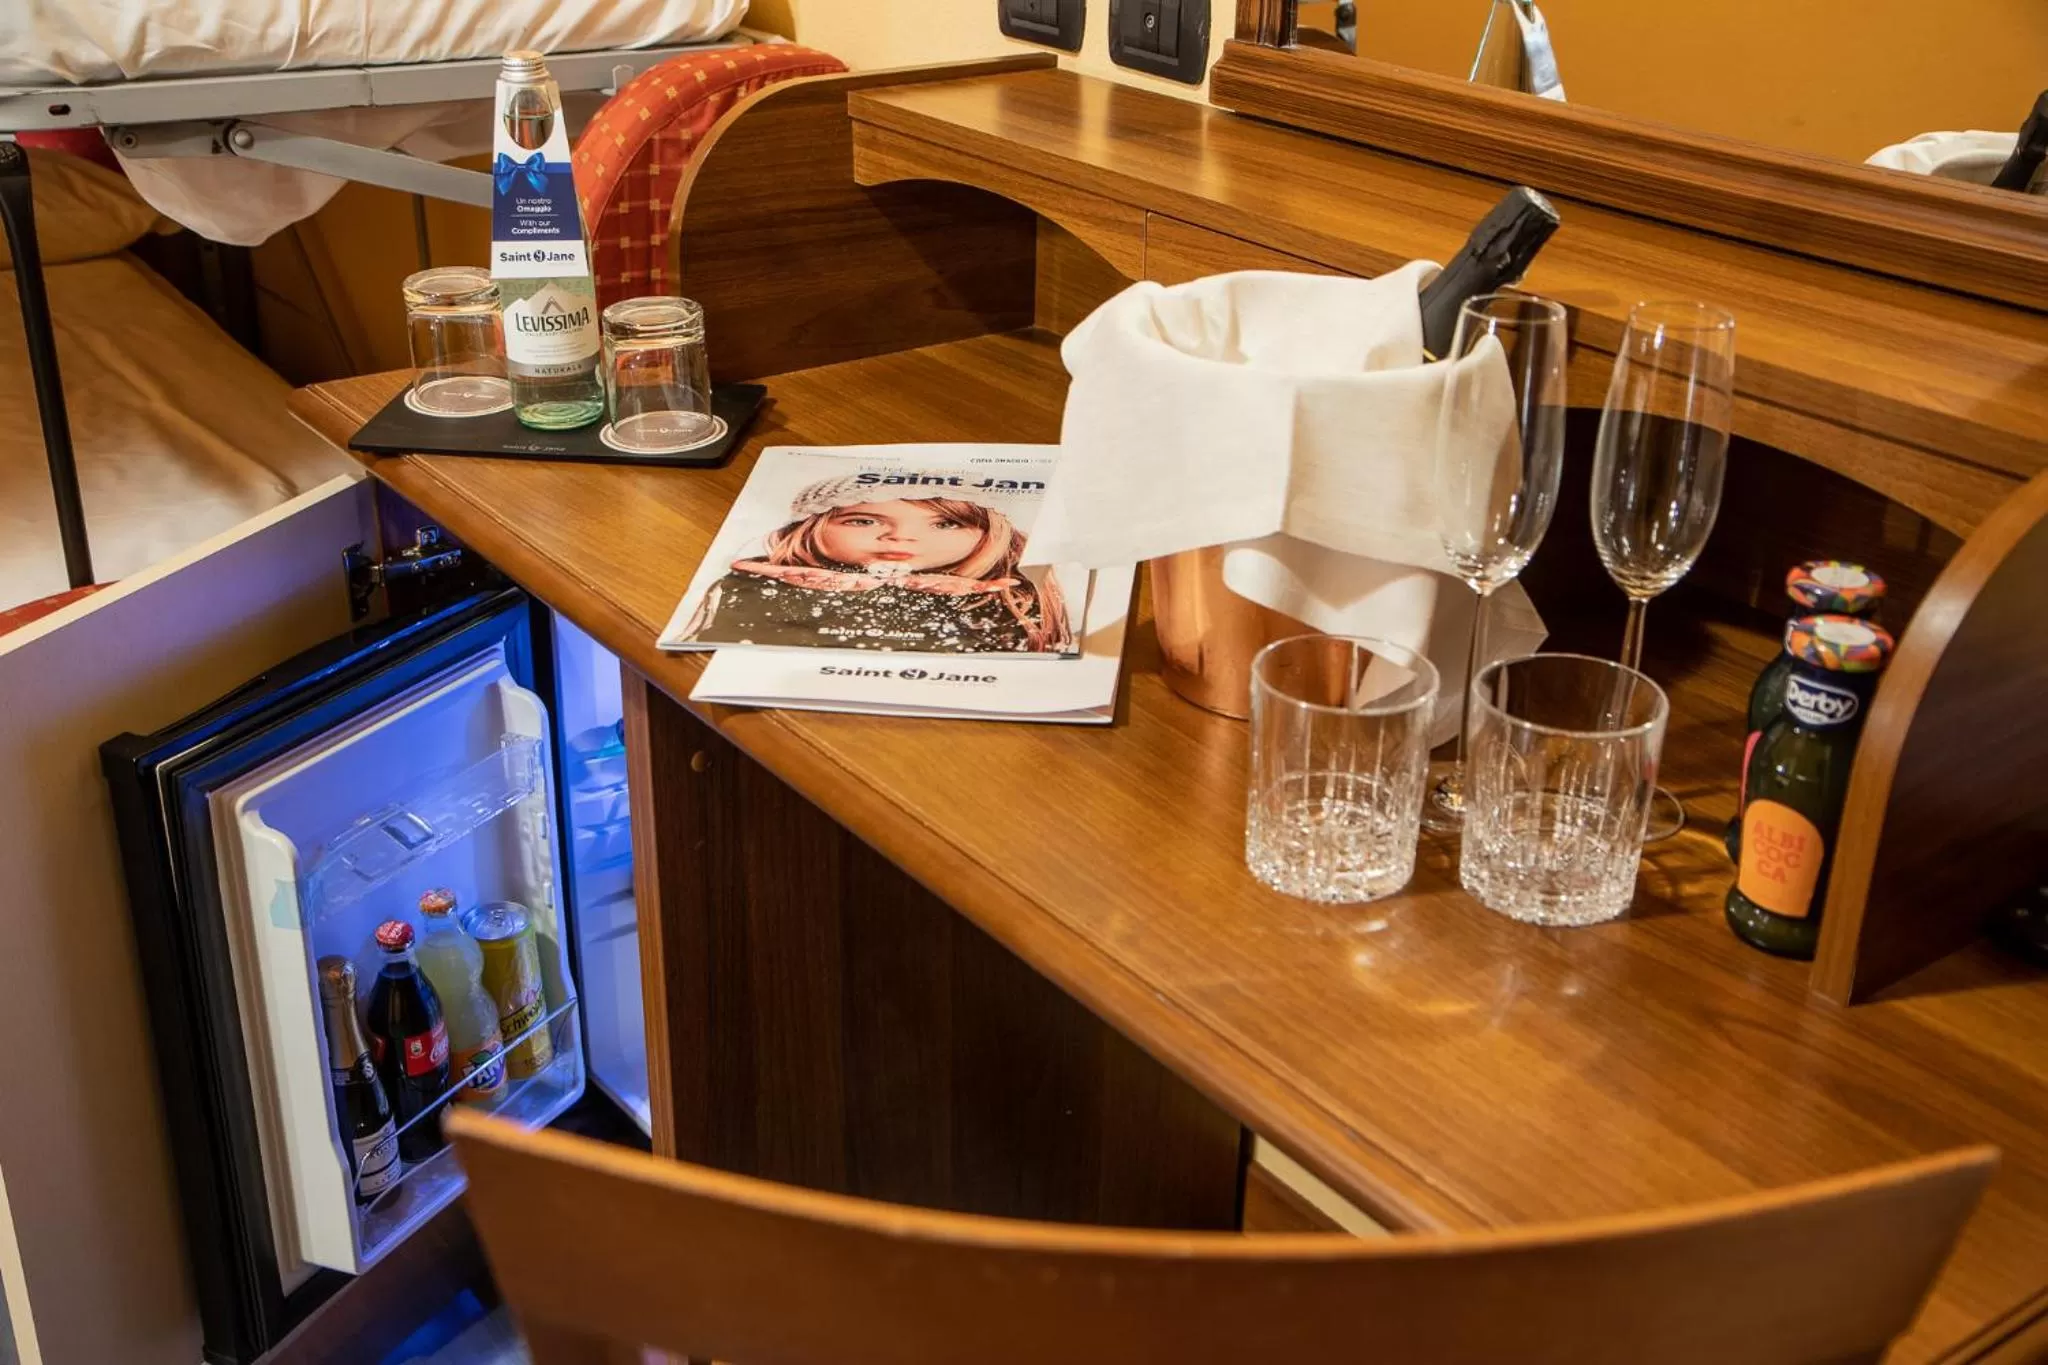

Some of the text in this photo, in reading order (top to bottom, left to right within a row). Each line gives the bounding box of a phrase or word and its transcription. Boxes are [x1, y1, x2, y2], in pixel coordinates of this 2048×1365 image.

[516, 197, 527, 205] Un
[516, 205, 552, 213] Omaggio
[511, 227, 560, 235] Compliments
[500, 251, 531, 262] Saint
[546, 252, 576, 262] Jane
[515, 306, 590, 332] LEVISSIMA
[855, 473, 1045, 490] Saint Jan
[817, 627, 864, 638] Saint
[819, 666, 894, 678] Saint
[930, 672, 998, 684] Jane
[1787, 680, 1854, 718] Derby
[1754, 821, 1805, 852] ALBI
[1754, 838, 1801, 868] COC
[1758, 859, 1787, 884] CA
